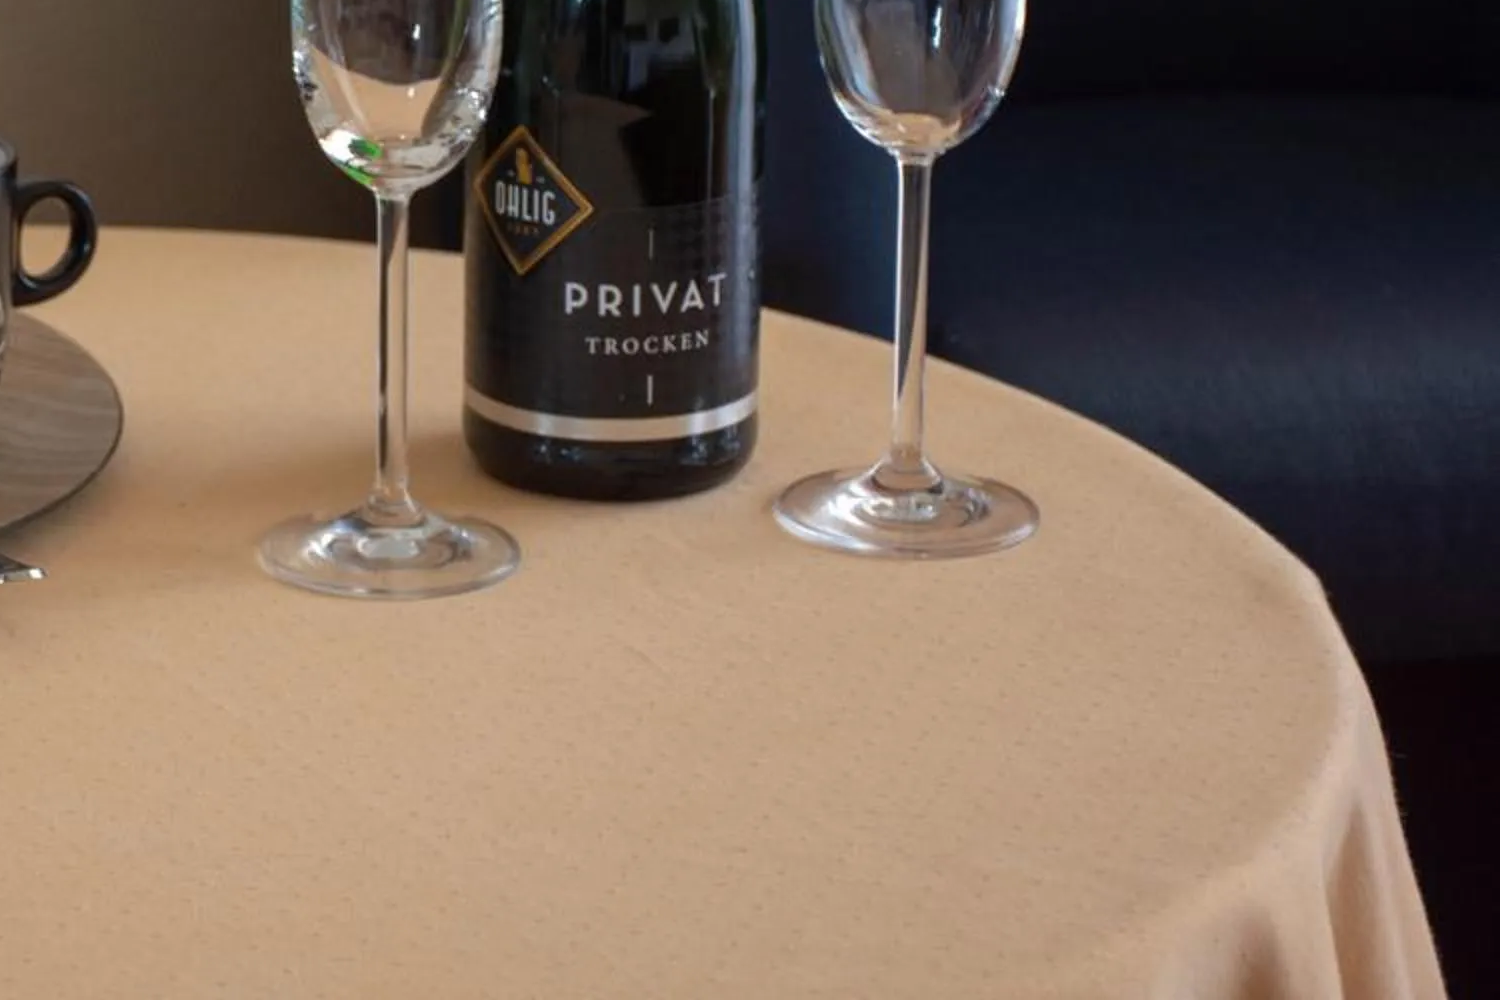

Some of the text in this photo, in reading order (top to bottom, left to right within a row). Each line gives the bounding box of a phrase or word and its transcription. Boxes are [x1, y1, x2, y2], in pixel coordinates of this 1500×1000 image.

[495, 180, 556, 226] OHLIG
[564, 271, 728, 317] PRIVAT
[585, 328, 710, 355] TROCKEN
